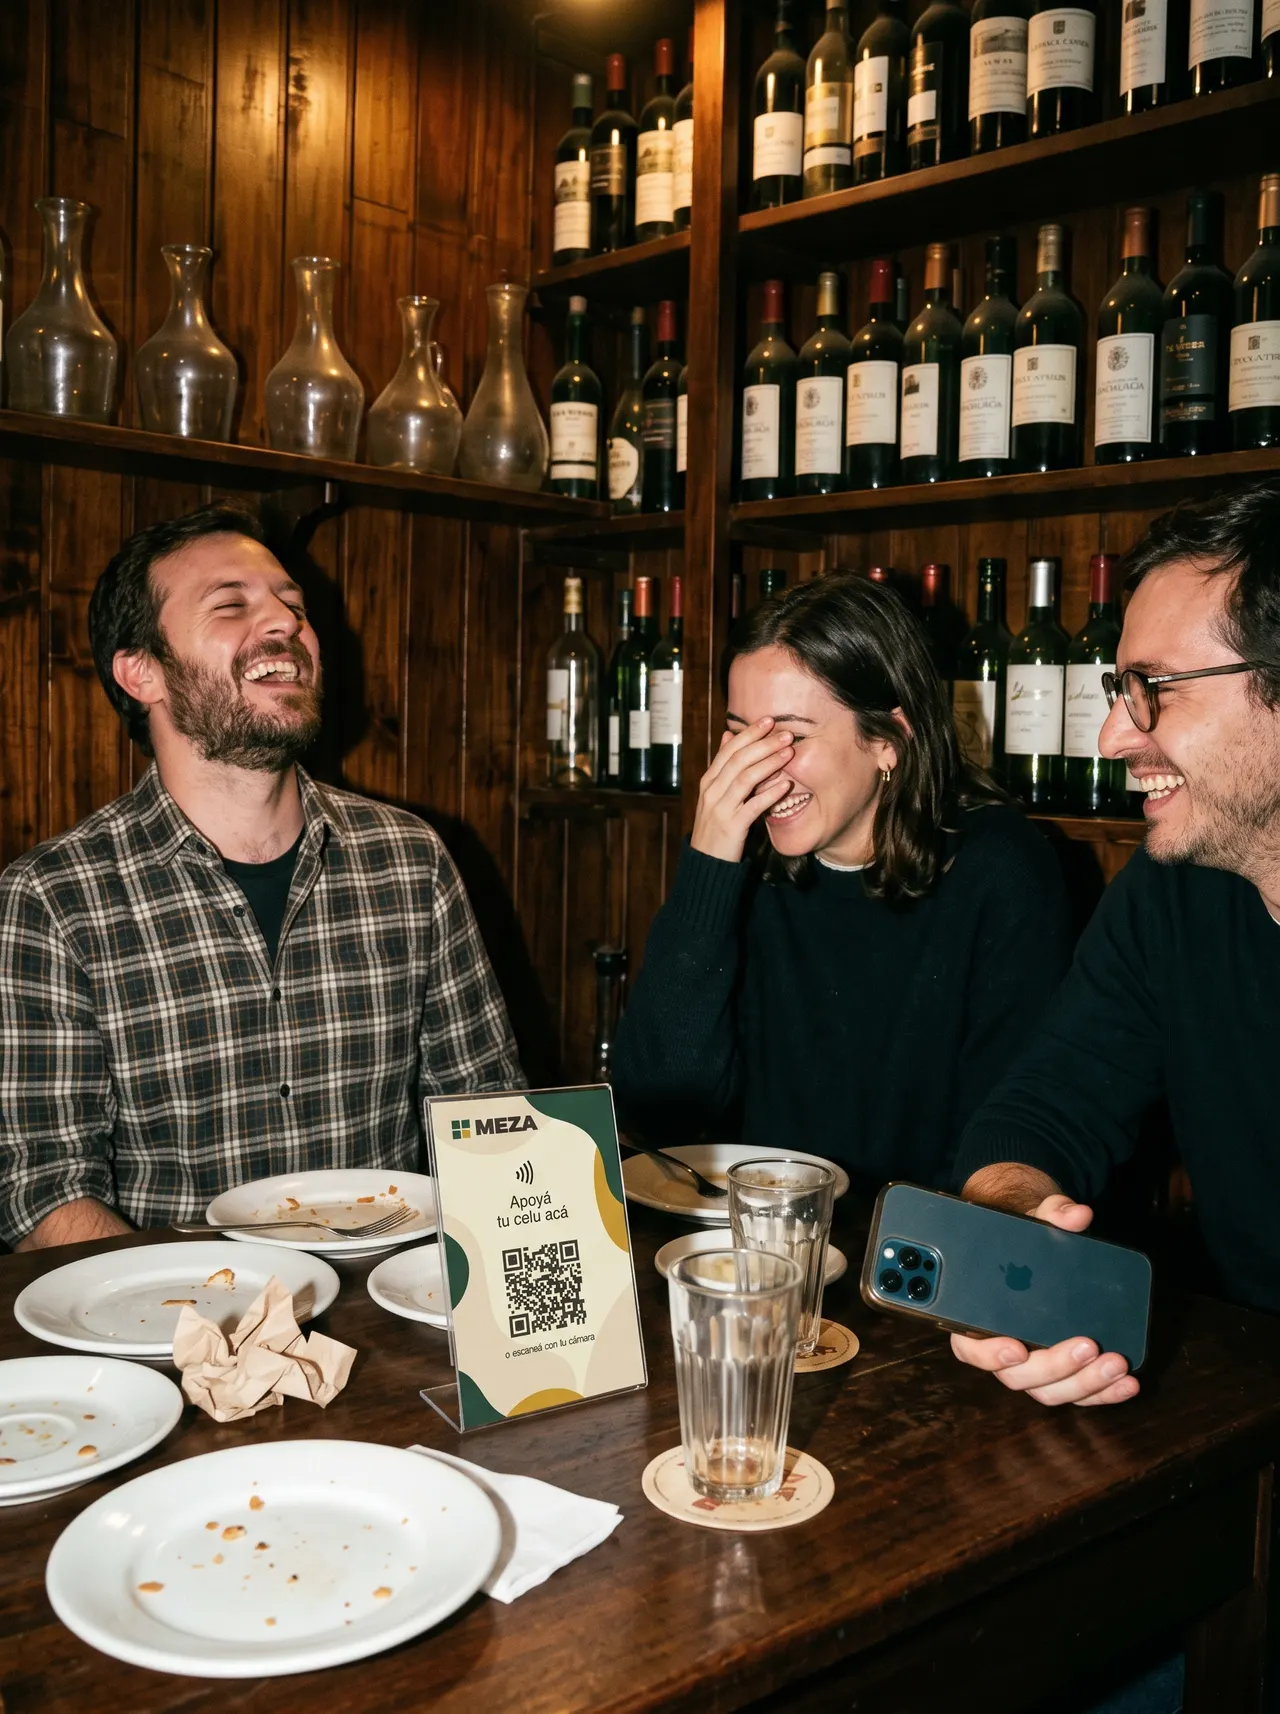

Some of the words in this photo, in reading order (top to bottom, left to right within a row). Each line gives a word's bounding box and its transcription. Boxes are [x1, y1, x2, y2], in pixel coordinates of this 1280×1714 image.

[475, 1115, 538, 1135] MEZA
[510, 1191, 551, 1211] Apoyá
[497, 1215, 510, 1228] tu
[514, 1210, 541, 1226] celu
[545, 1205, 569, 1221] acá
[504, 1351, 511, 1359] o
[512, 1343, 543, 1357] escaneá
[544, 1341, 558, 1351] con
[568, 1333, 596, 1345] cámara
